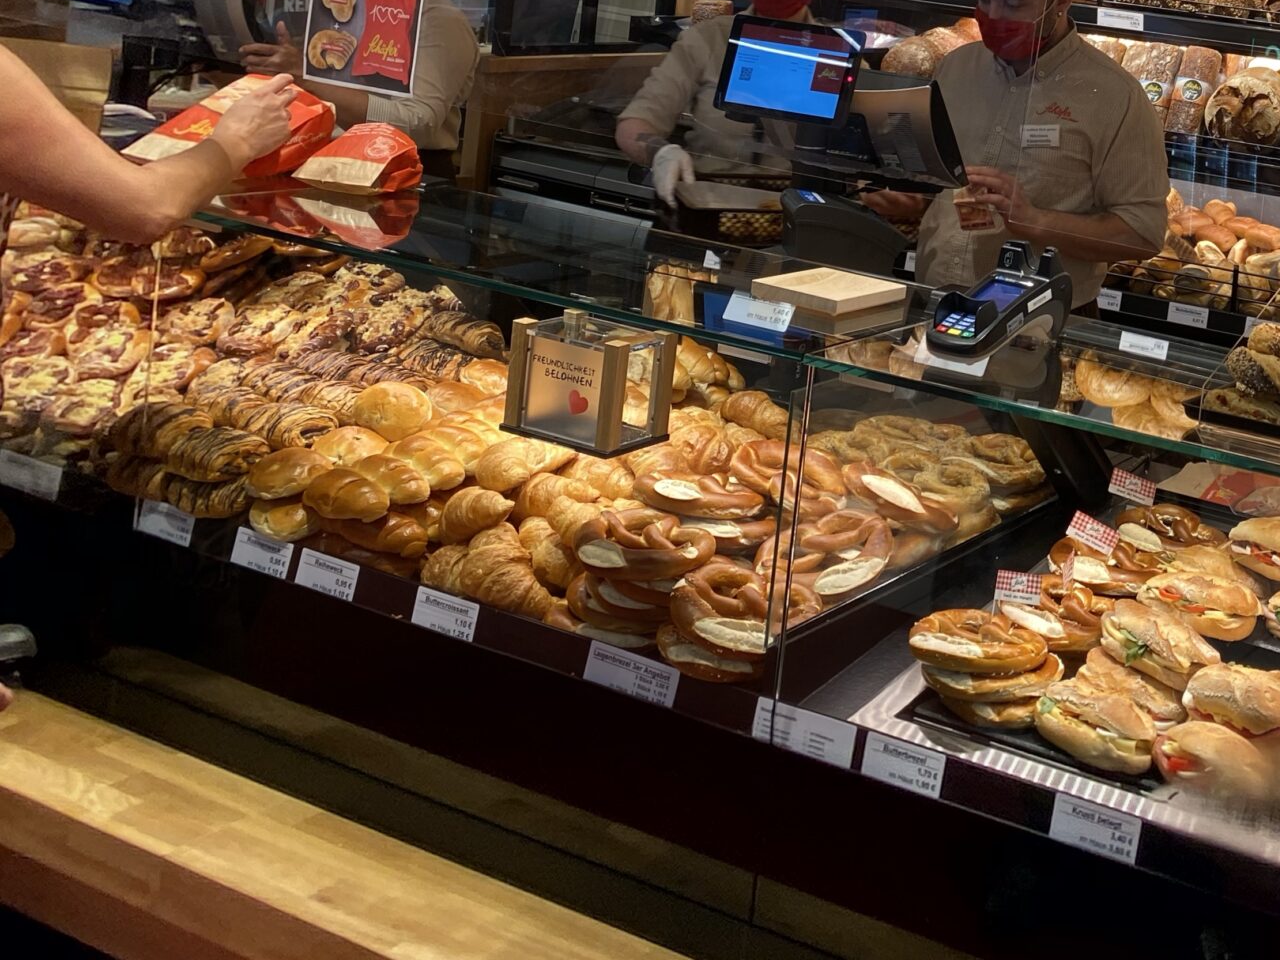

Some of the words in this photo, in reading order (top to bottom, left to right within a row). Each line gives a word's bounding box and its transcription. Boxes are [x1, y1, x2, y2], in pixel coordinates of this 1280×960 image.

[532, 353, 596, 377] FREUNDLICHKEIT
[544, 367, 593, 388] BELOHNEN
[425, 595, 469, 615] Buttercroissant
[455, 618, 467, 629] 1,10
[467, 622, 472, 630] €
